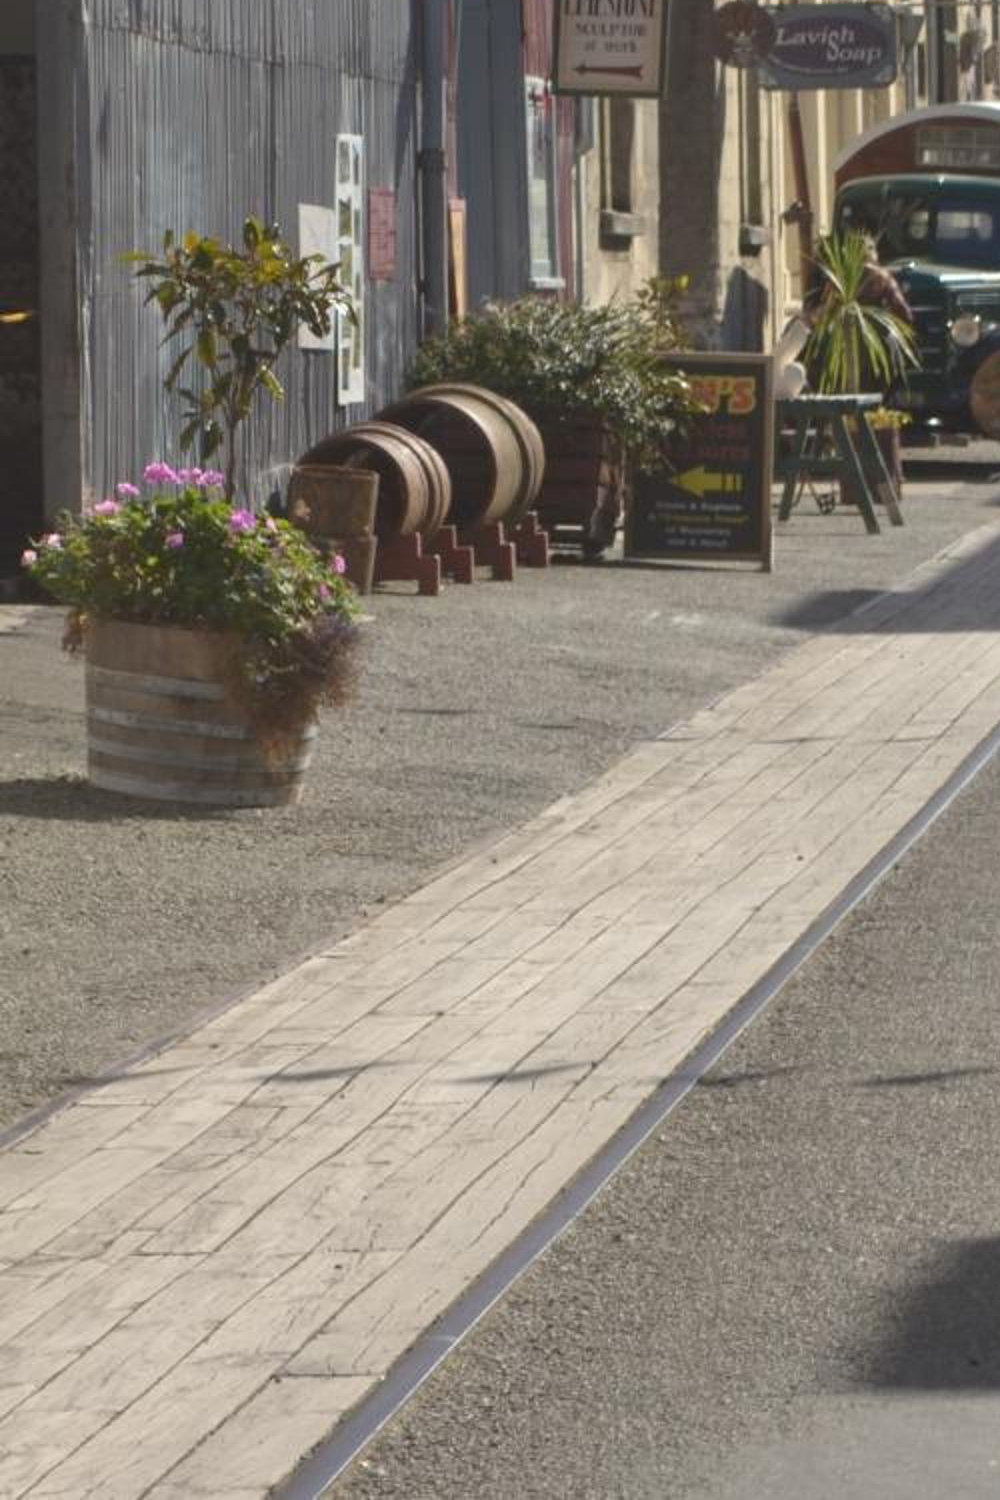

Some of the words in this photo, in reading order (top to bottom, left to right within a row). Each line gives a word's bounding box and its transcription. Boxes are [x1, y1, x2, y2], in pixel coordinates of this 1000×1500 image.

[576, 23, 647, 38] SCULPTOR
[775, 24, 855, 47] Lavish
[826, 36, 882, 66] Soap
